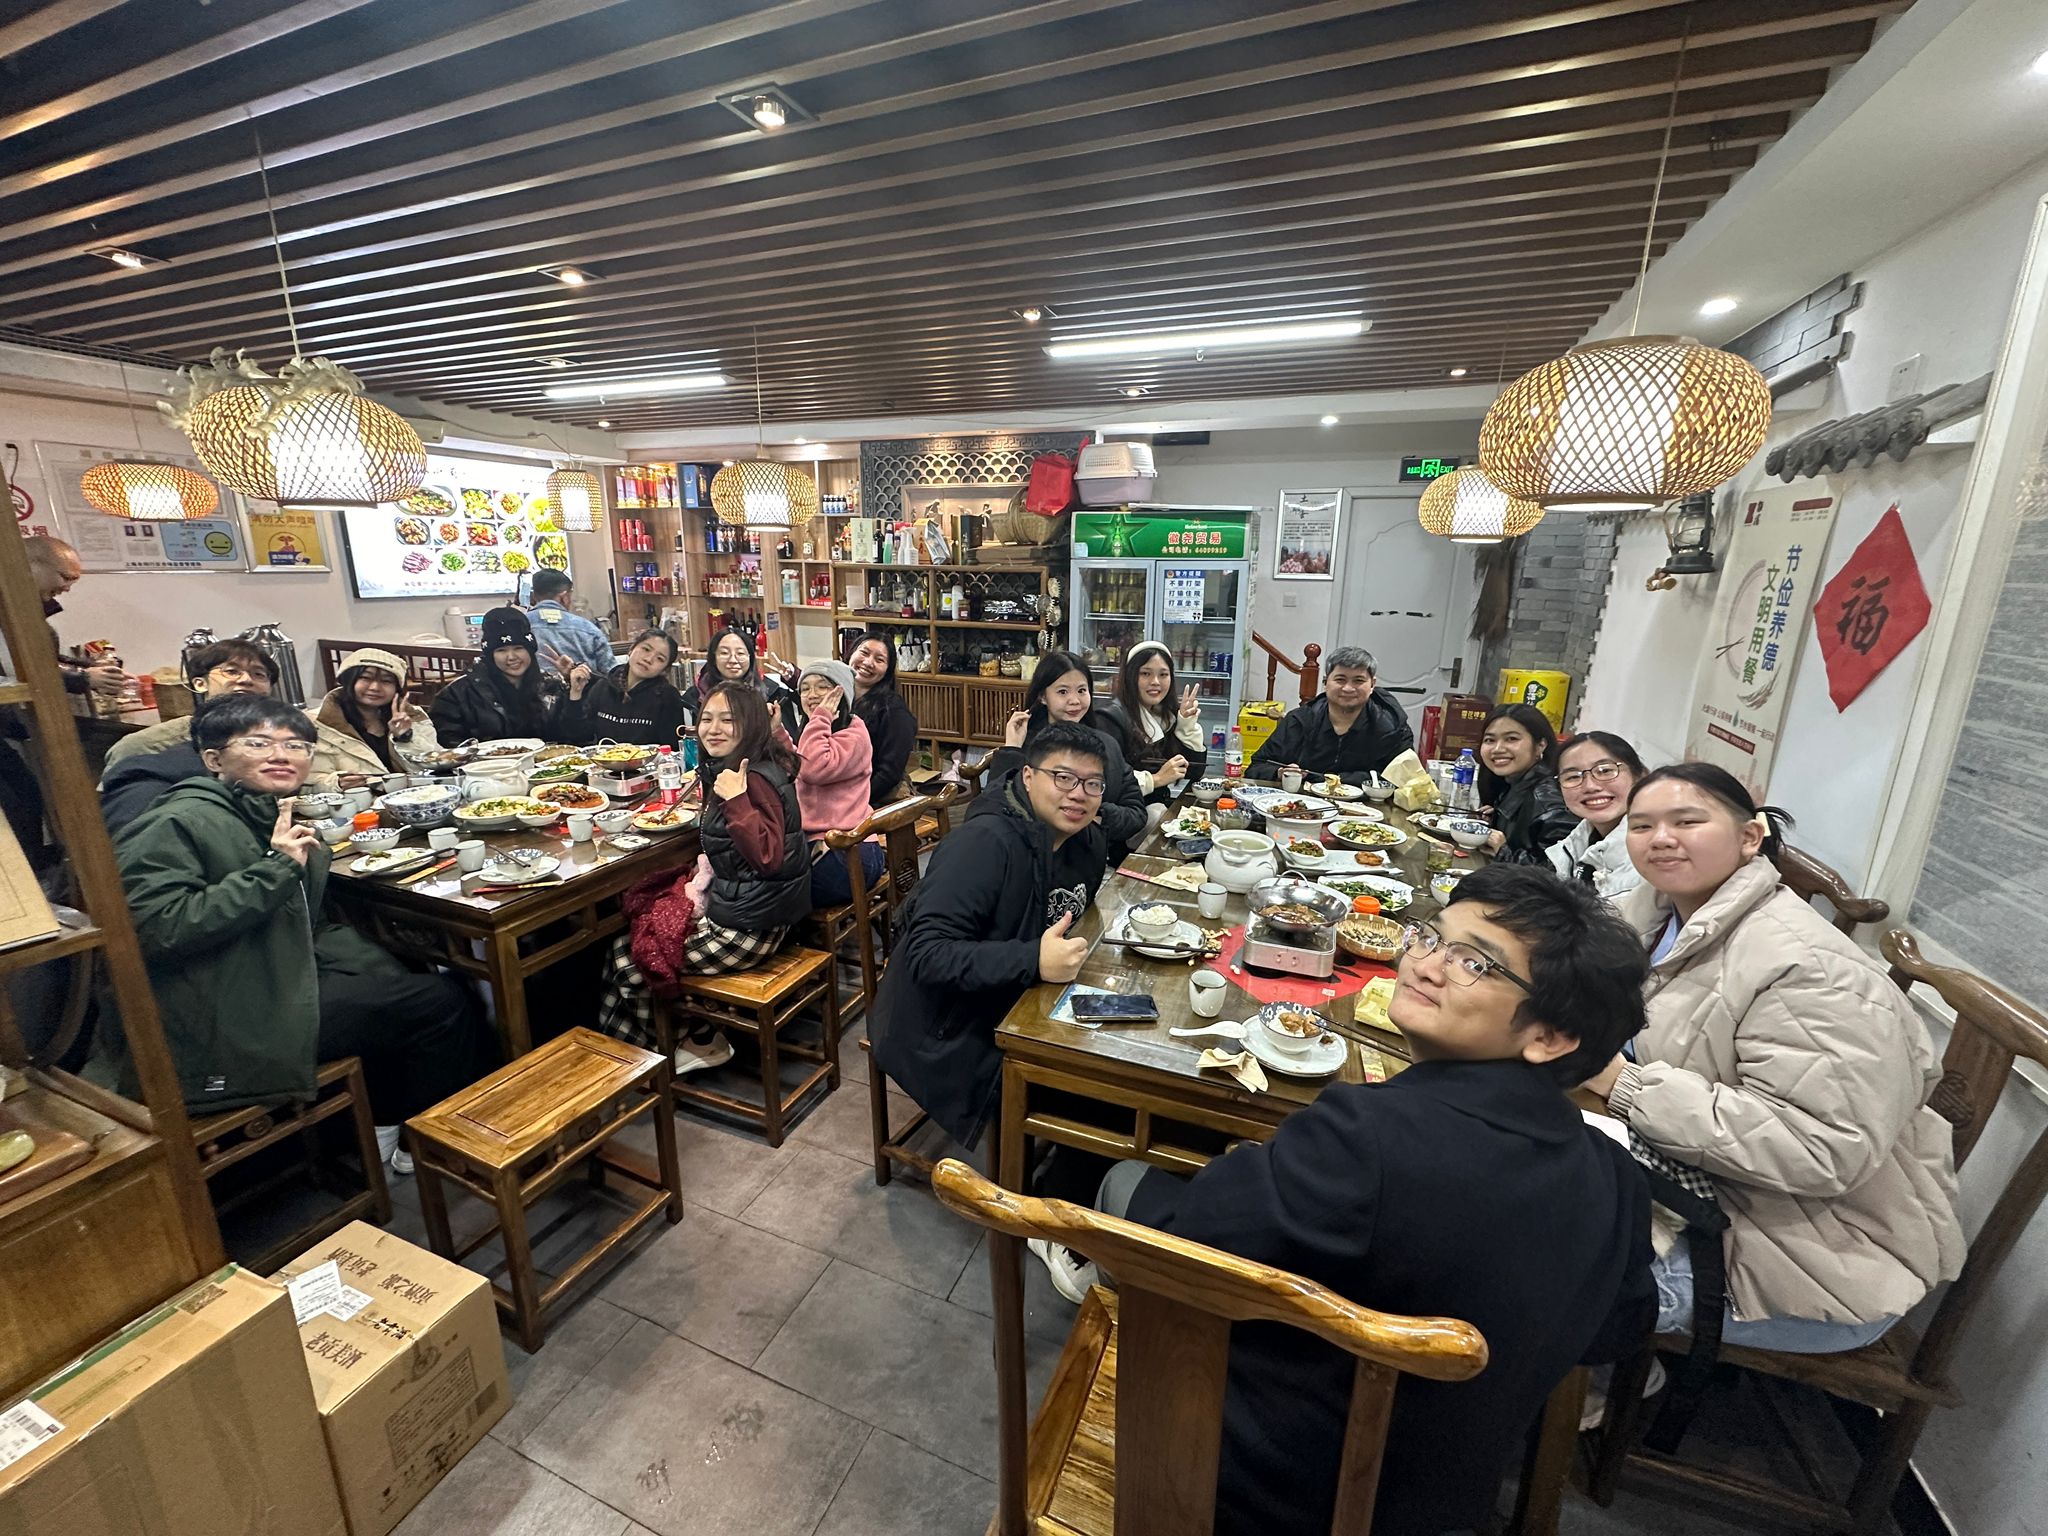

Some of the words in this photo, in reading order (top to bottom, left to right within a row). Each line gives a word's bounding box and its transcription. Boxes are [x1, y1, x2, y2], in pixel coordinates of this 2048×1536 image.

[1742, 563, 1781, 685] 文明用餐
[1760, 544, 1803, 672] 节俭养德
[1836, 575, 1891, 656] 福
